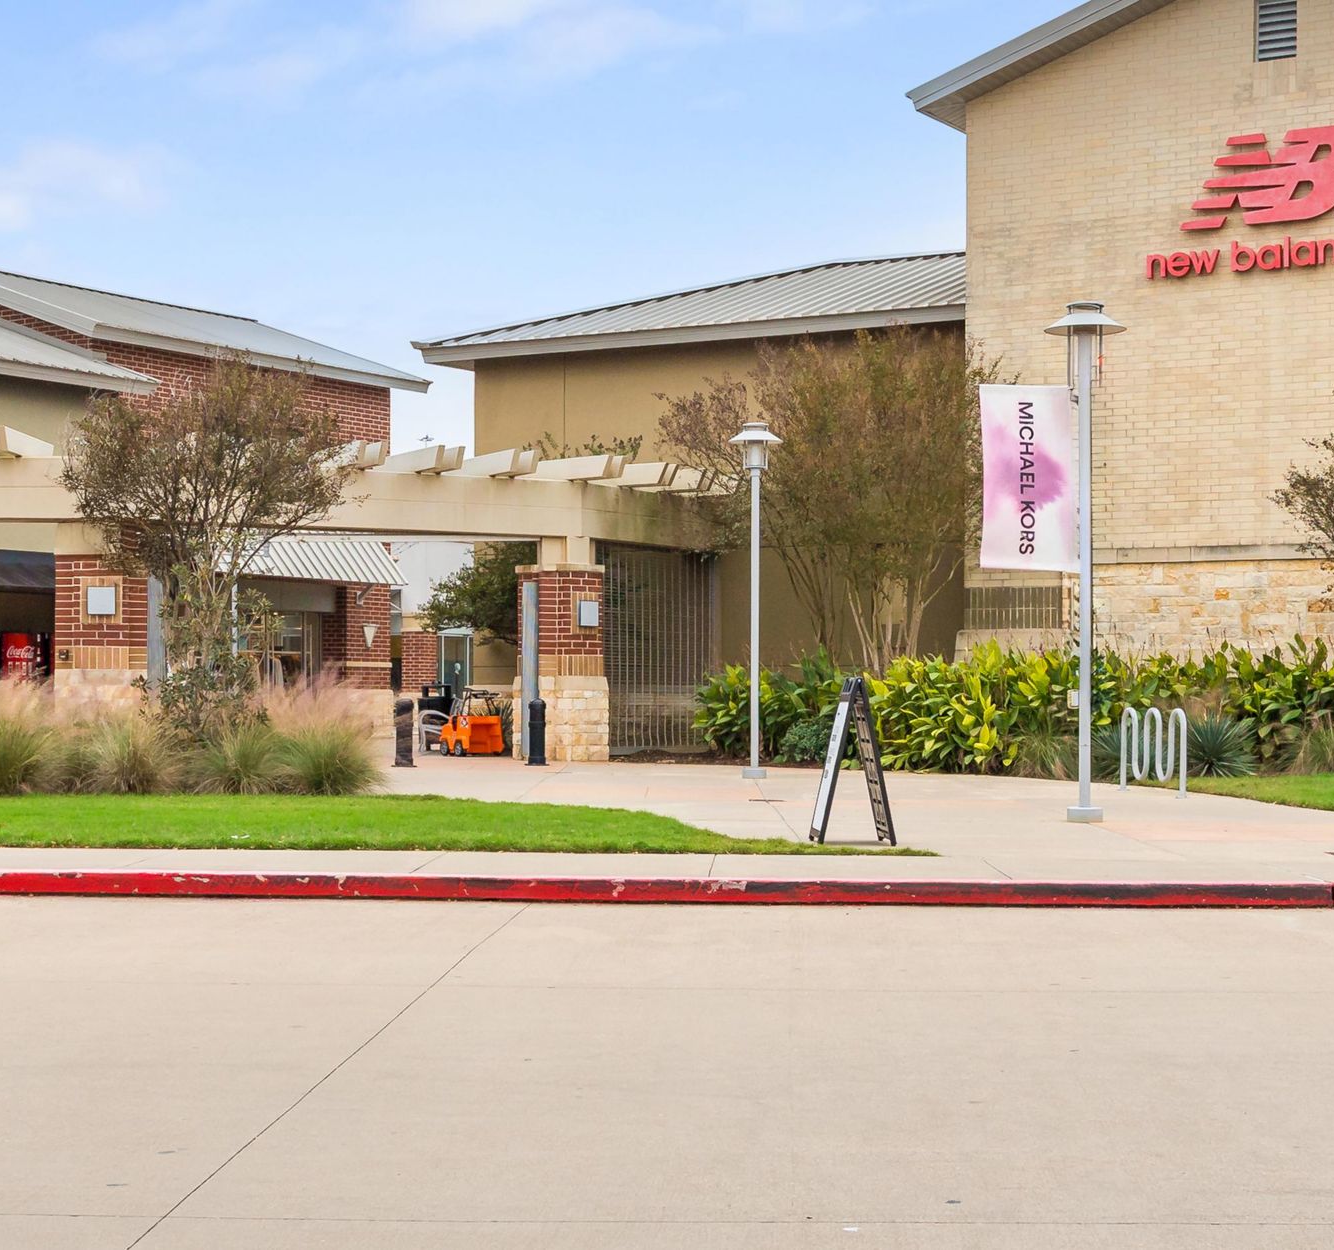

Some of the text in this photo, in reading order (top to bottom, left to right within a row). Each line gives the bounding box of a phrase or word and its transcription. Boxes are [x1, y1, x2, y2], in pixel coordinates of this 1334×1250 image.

[1146, 248, 1220, 280] new
[1018, 401, 1036, 555] MICHAEL KORS
